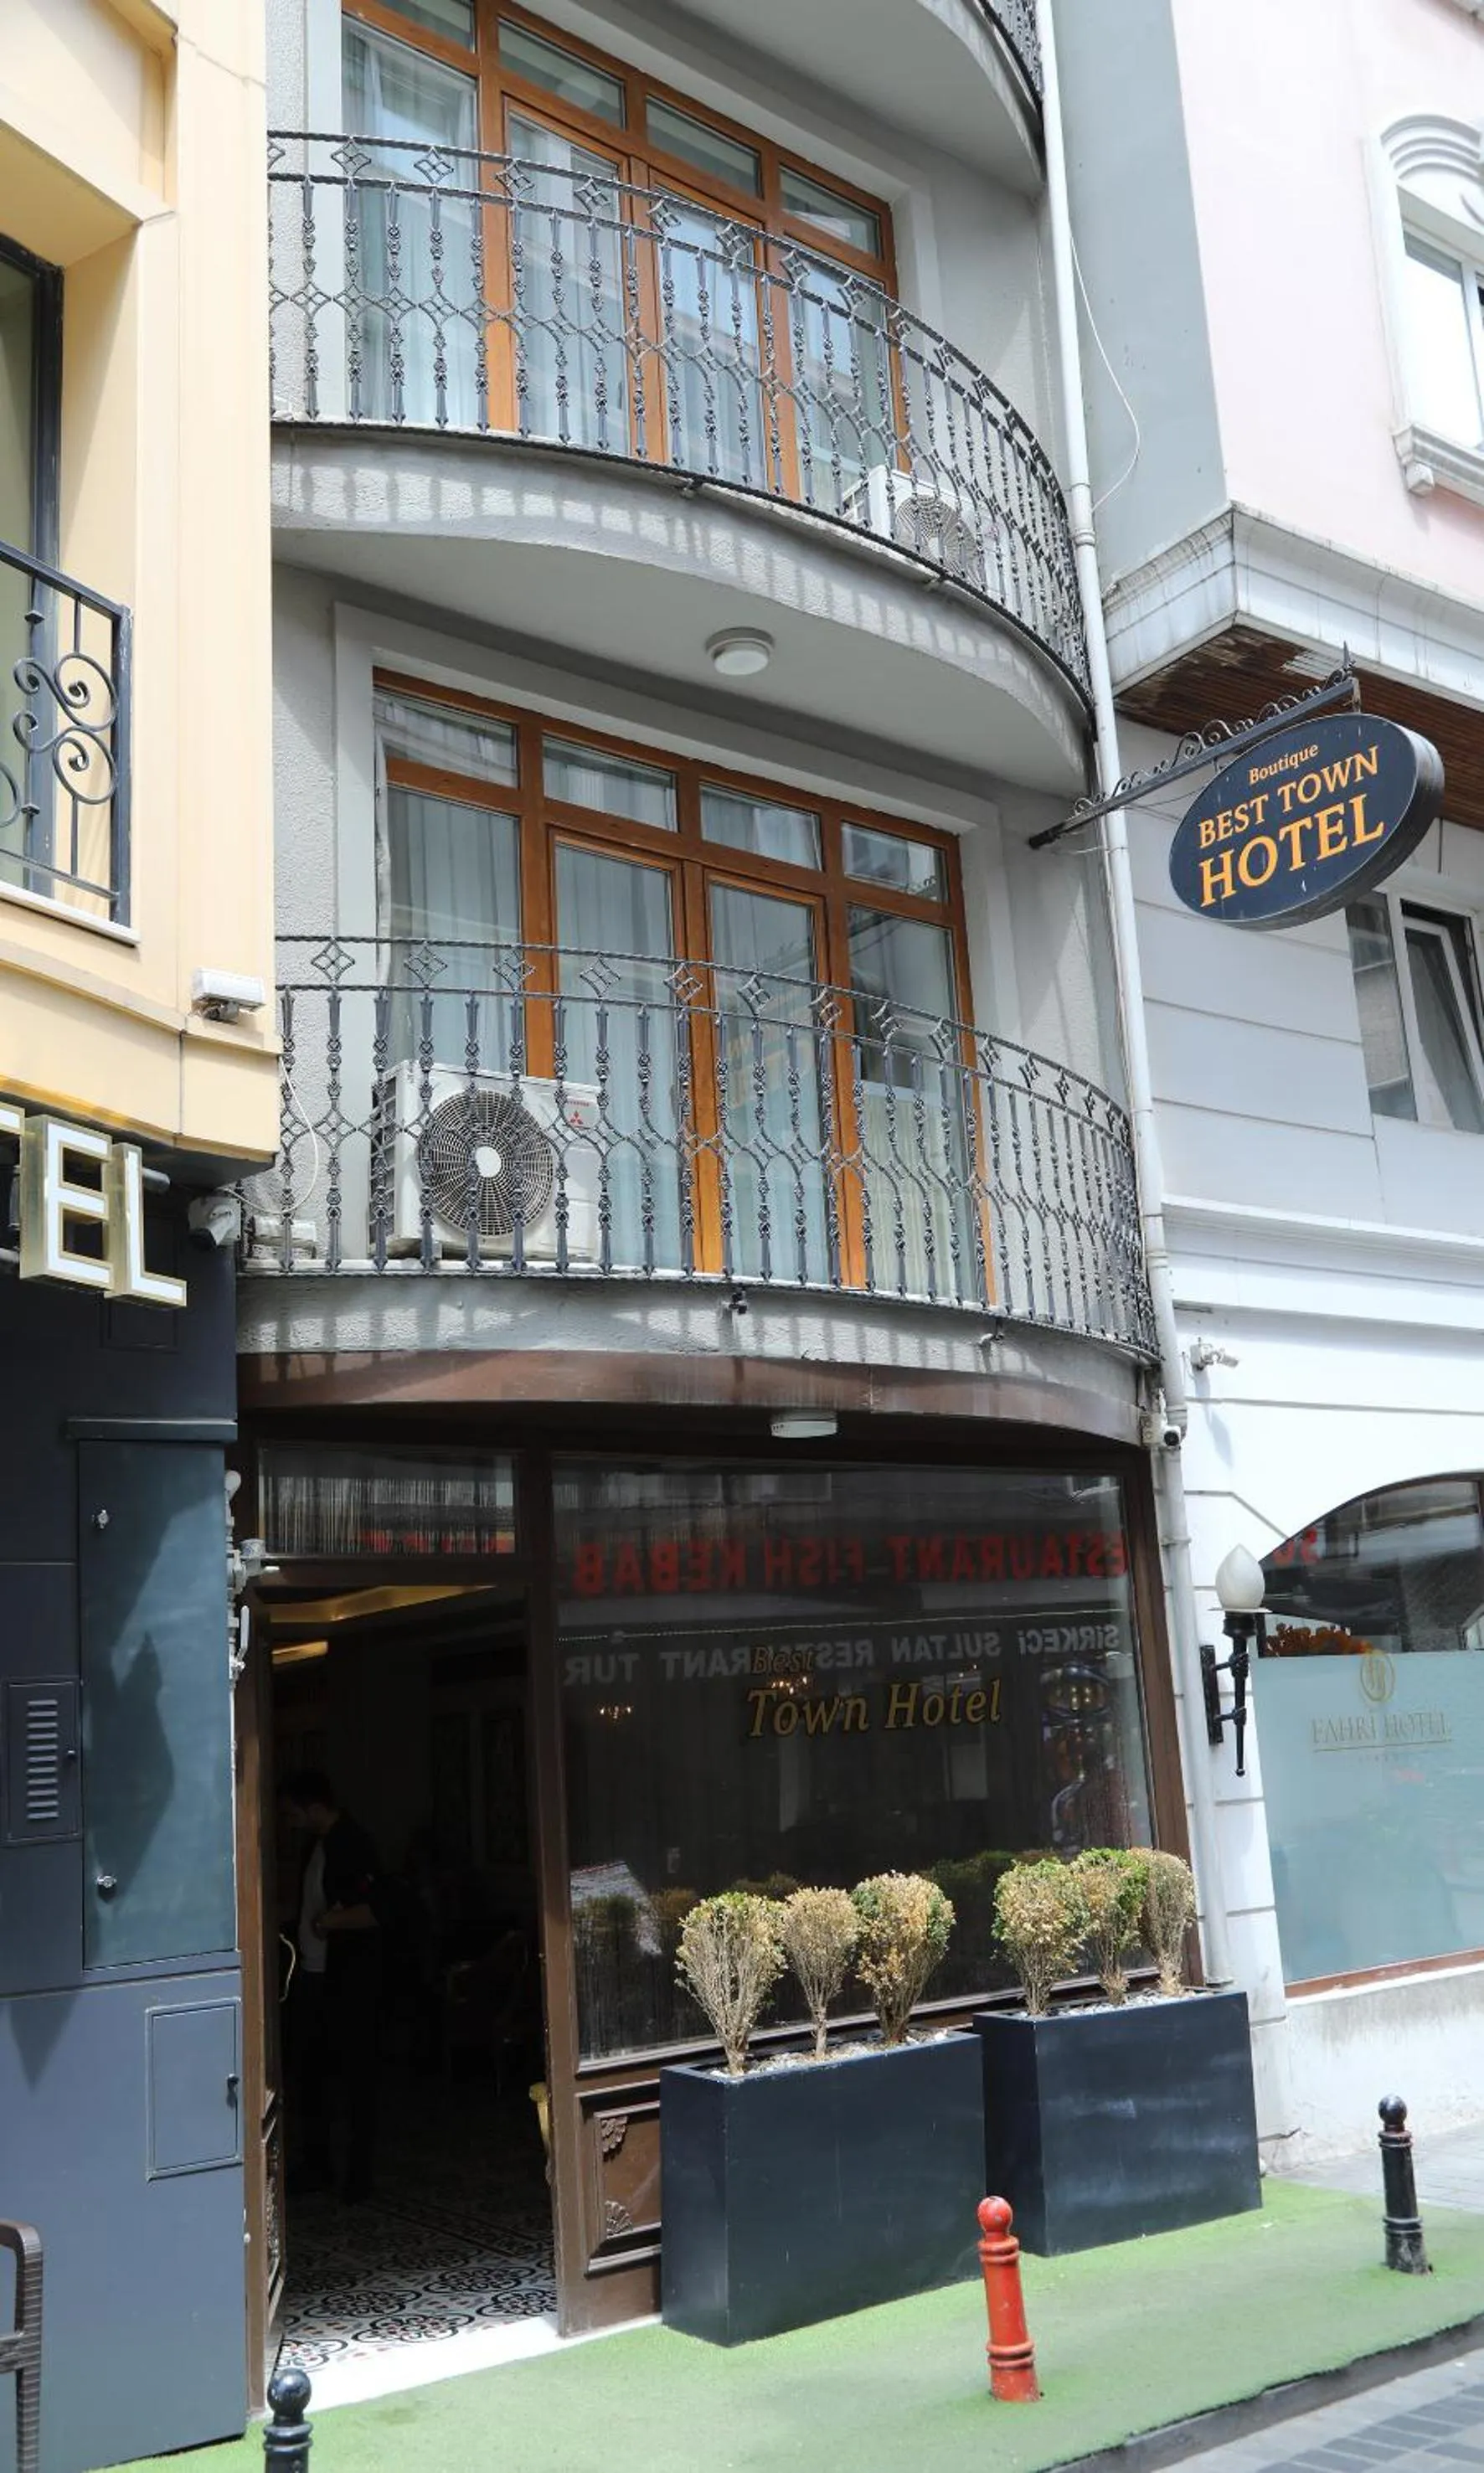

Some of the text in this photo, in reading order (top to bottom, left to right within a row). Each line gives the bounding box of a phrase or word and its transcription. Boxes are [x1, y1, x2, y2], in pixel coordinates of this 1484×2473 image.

[1198, 744, 1378, 849] BEST TOWN
[1249, 744, 1319, 786] Boutique
[1199, 795, 1384, 907] HOTEL
[0, 1101, 187, 1306] EL
[750, 1644, 815, 1675] Best
[748, 1680, 1002, 1739] Town Hotel
